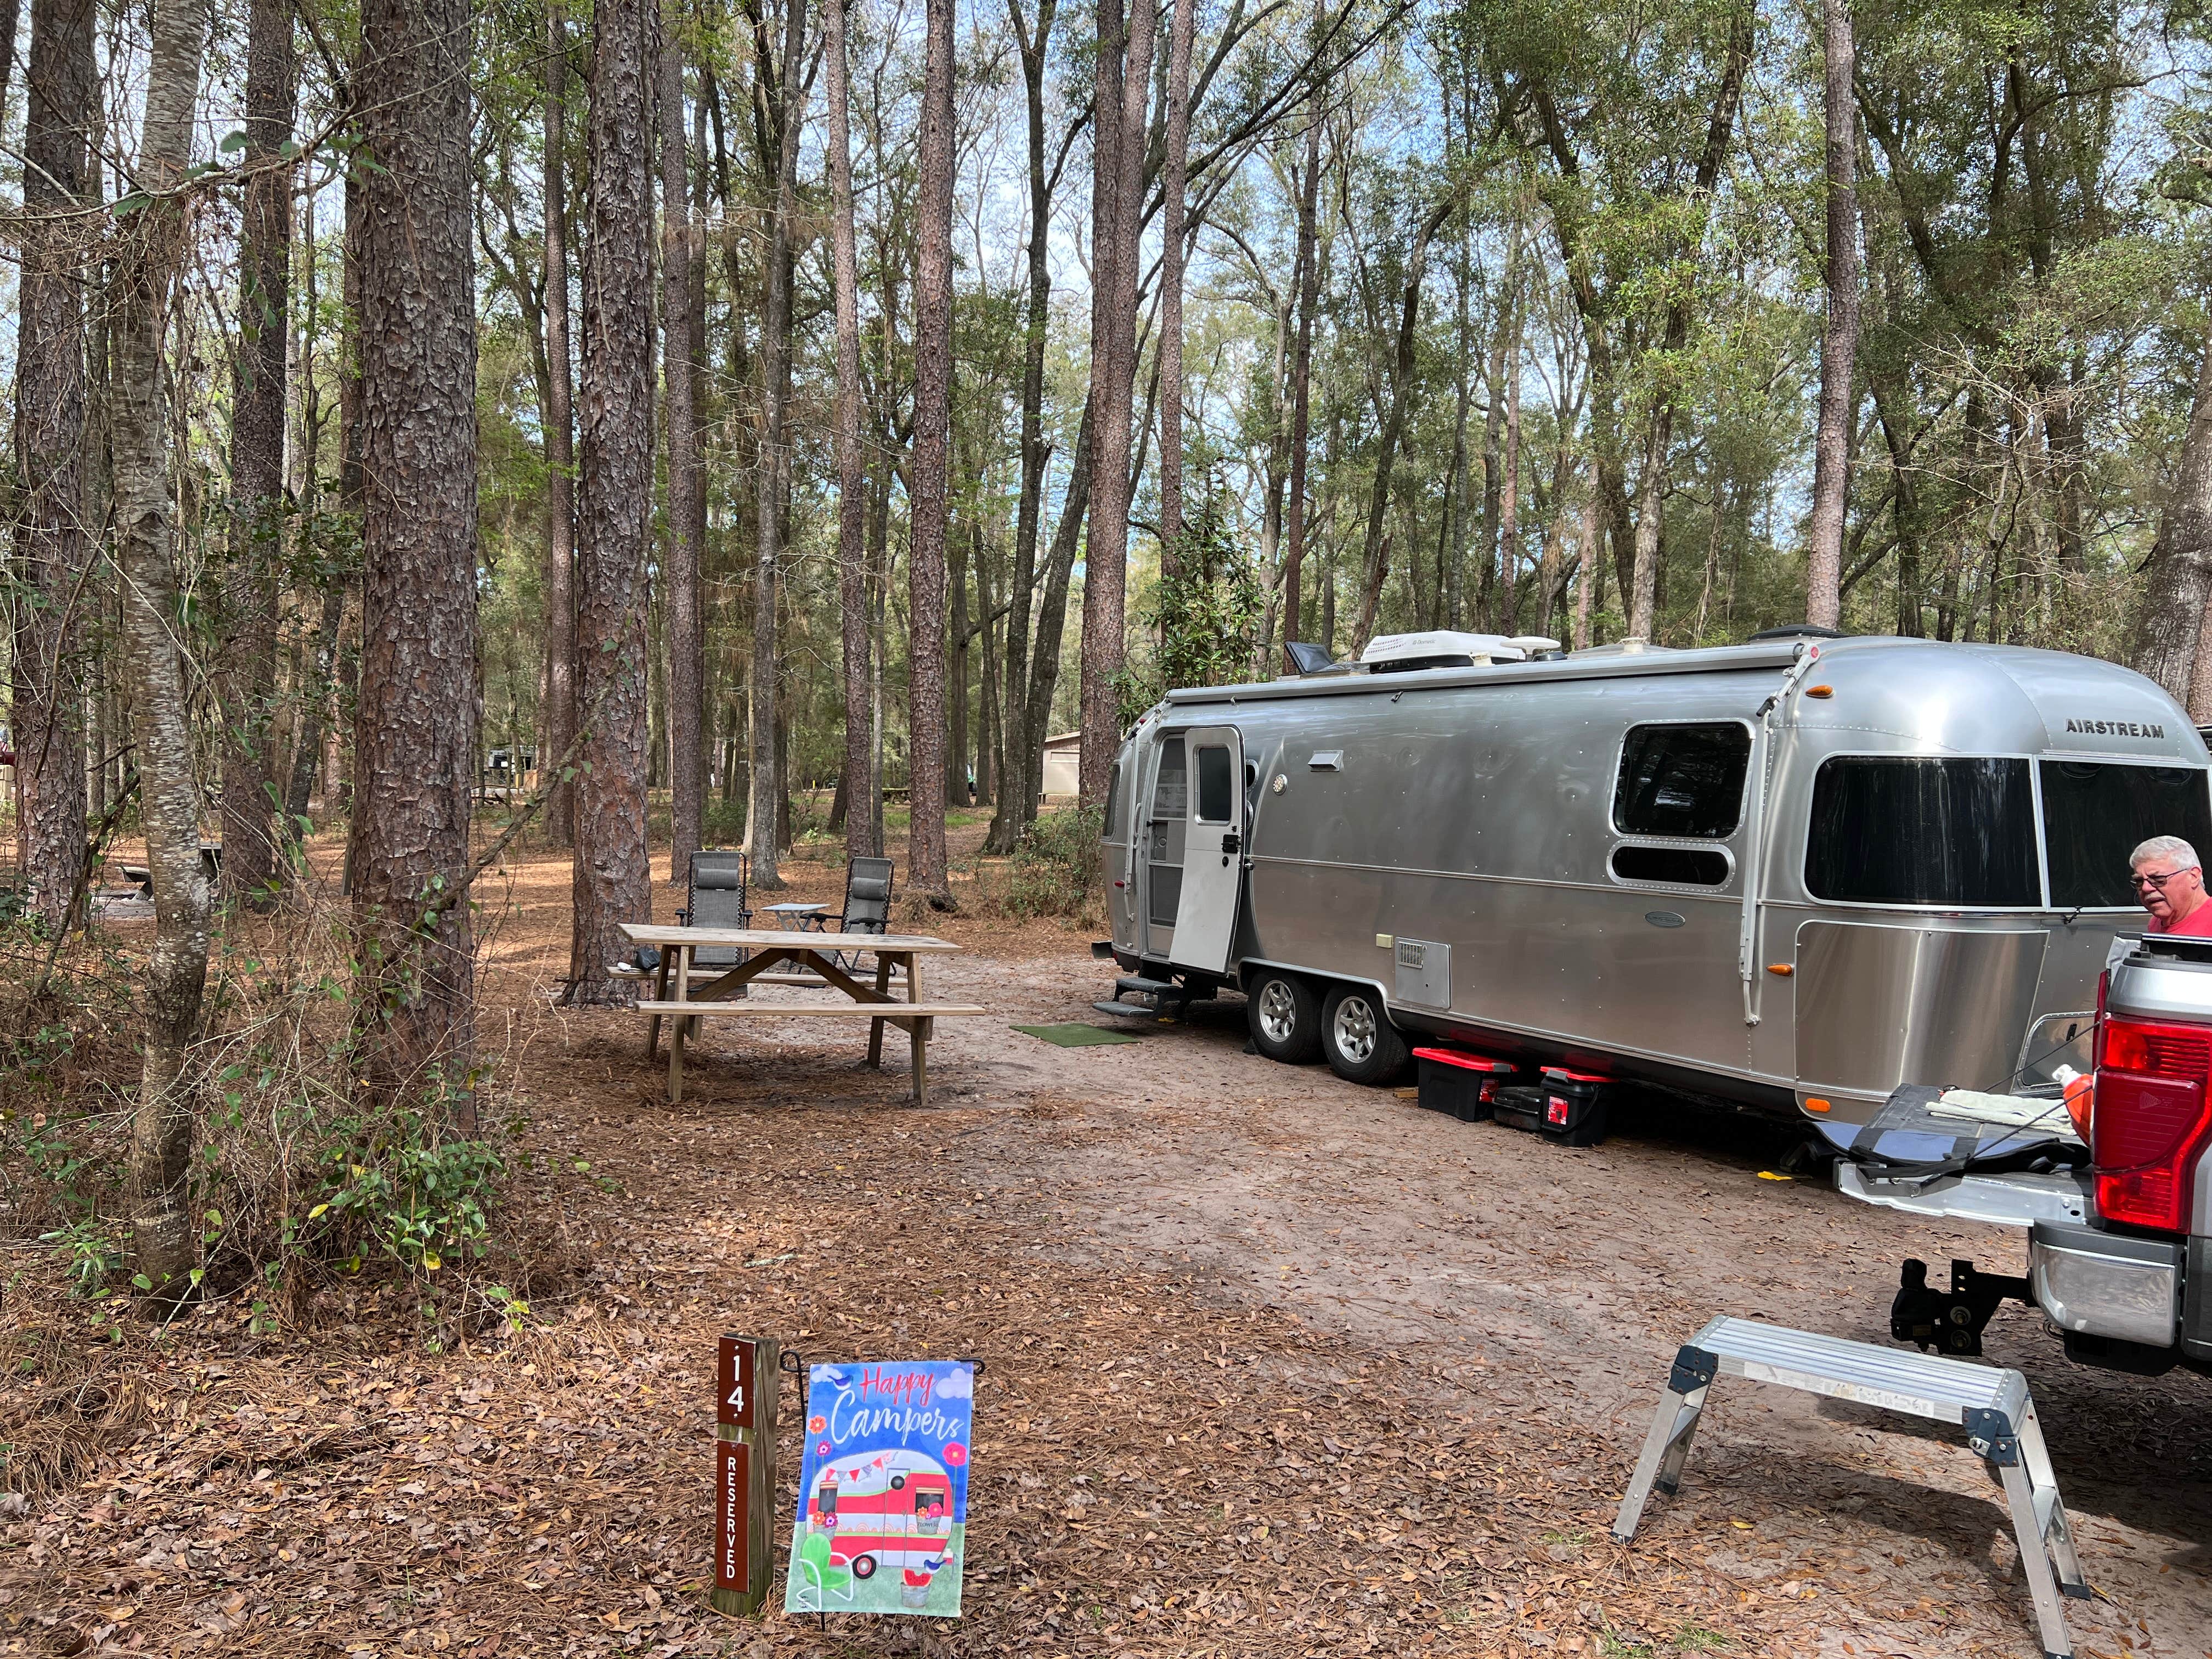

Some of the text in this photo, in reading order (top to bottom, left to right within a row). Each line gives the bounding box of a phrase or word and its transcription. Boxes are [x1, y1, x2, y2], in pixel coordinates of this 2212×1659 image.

[2066, 718, 2164, 738] AIRSTREAM
[859, 1366, 937, 1407] Happy
[831, 1389, 964, 1446] Campers
[726, 1457, 736, 1578] RESERVED
